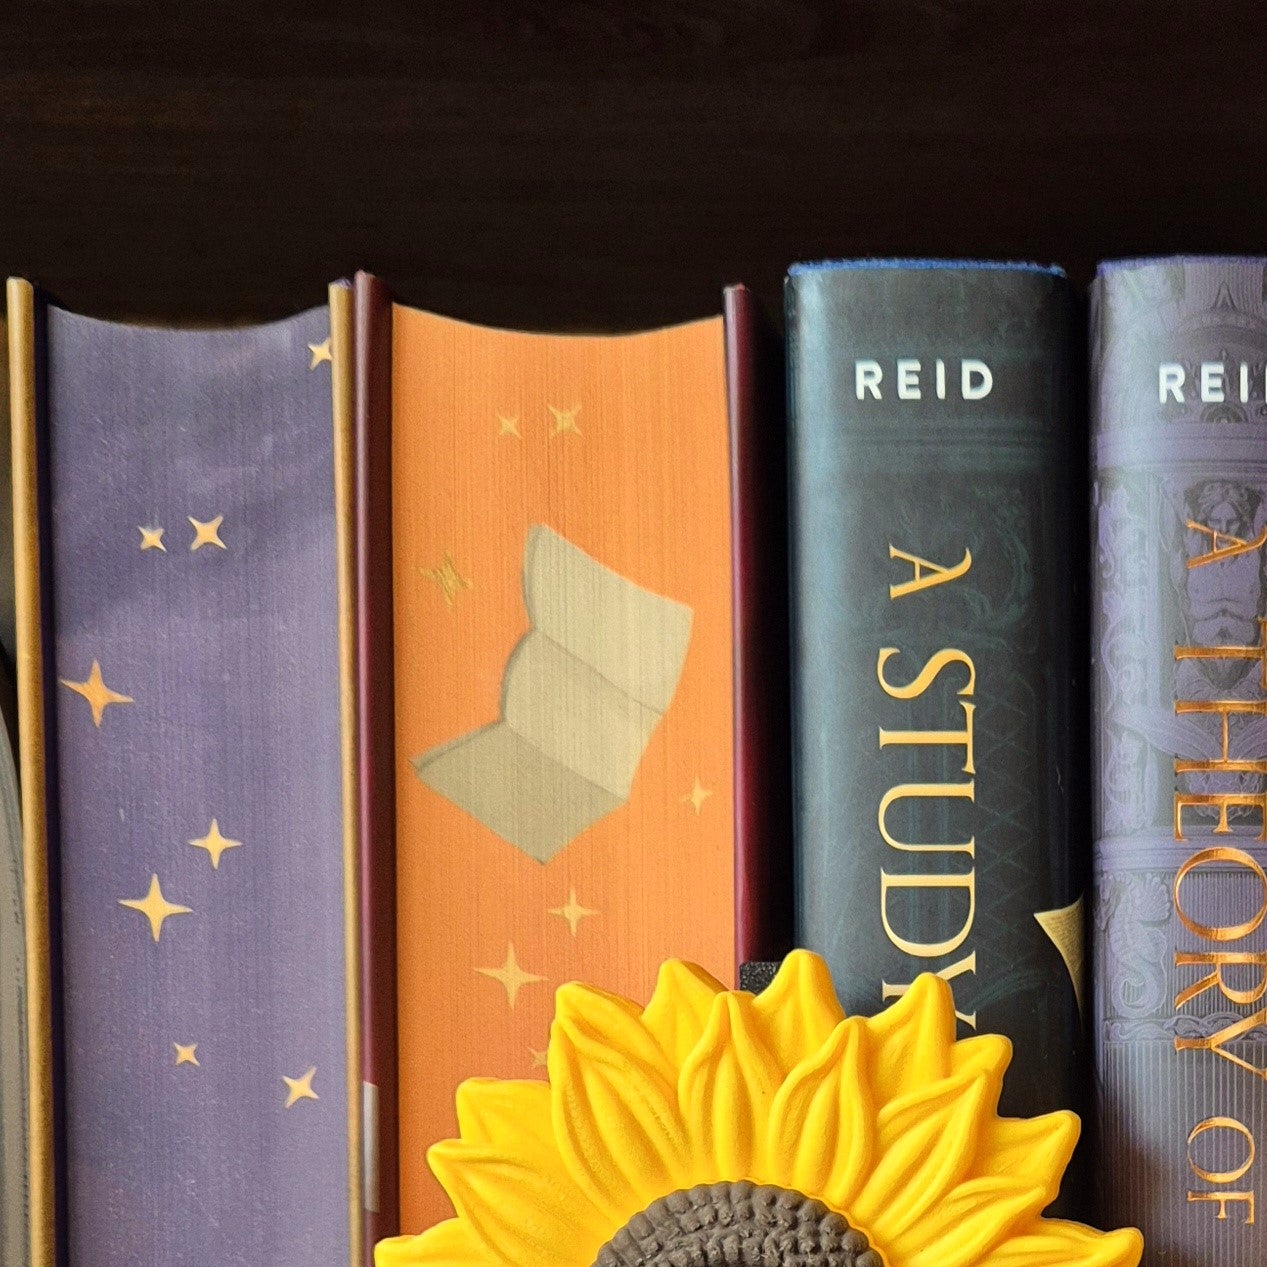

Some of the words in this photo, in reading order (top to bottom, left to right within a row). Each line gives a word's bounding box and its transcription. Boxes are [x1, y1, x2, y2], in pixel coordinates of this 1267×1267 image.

[855, 359, 995, 401] REID
[888, 543, 973, 600] A
[1186, 1115, 1257, 1225] OF
